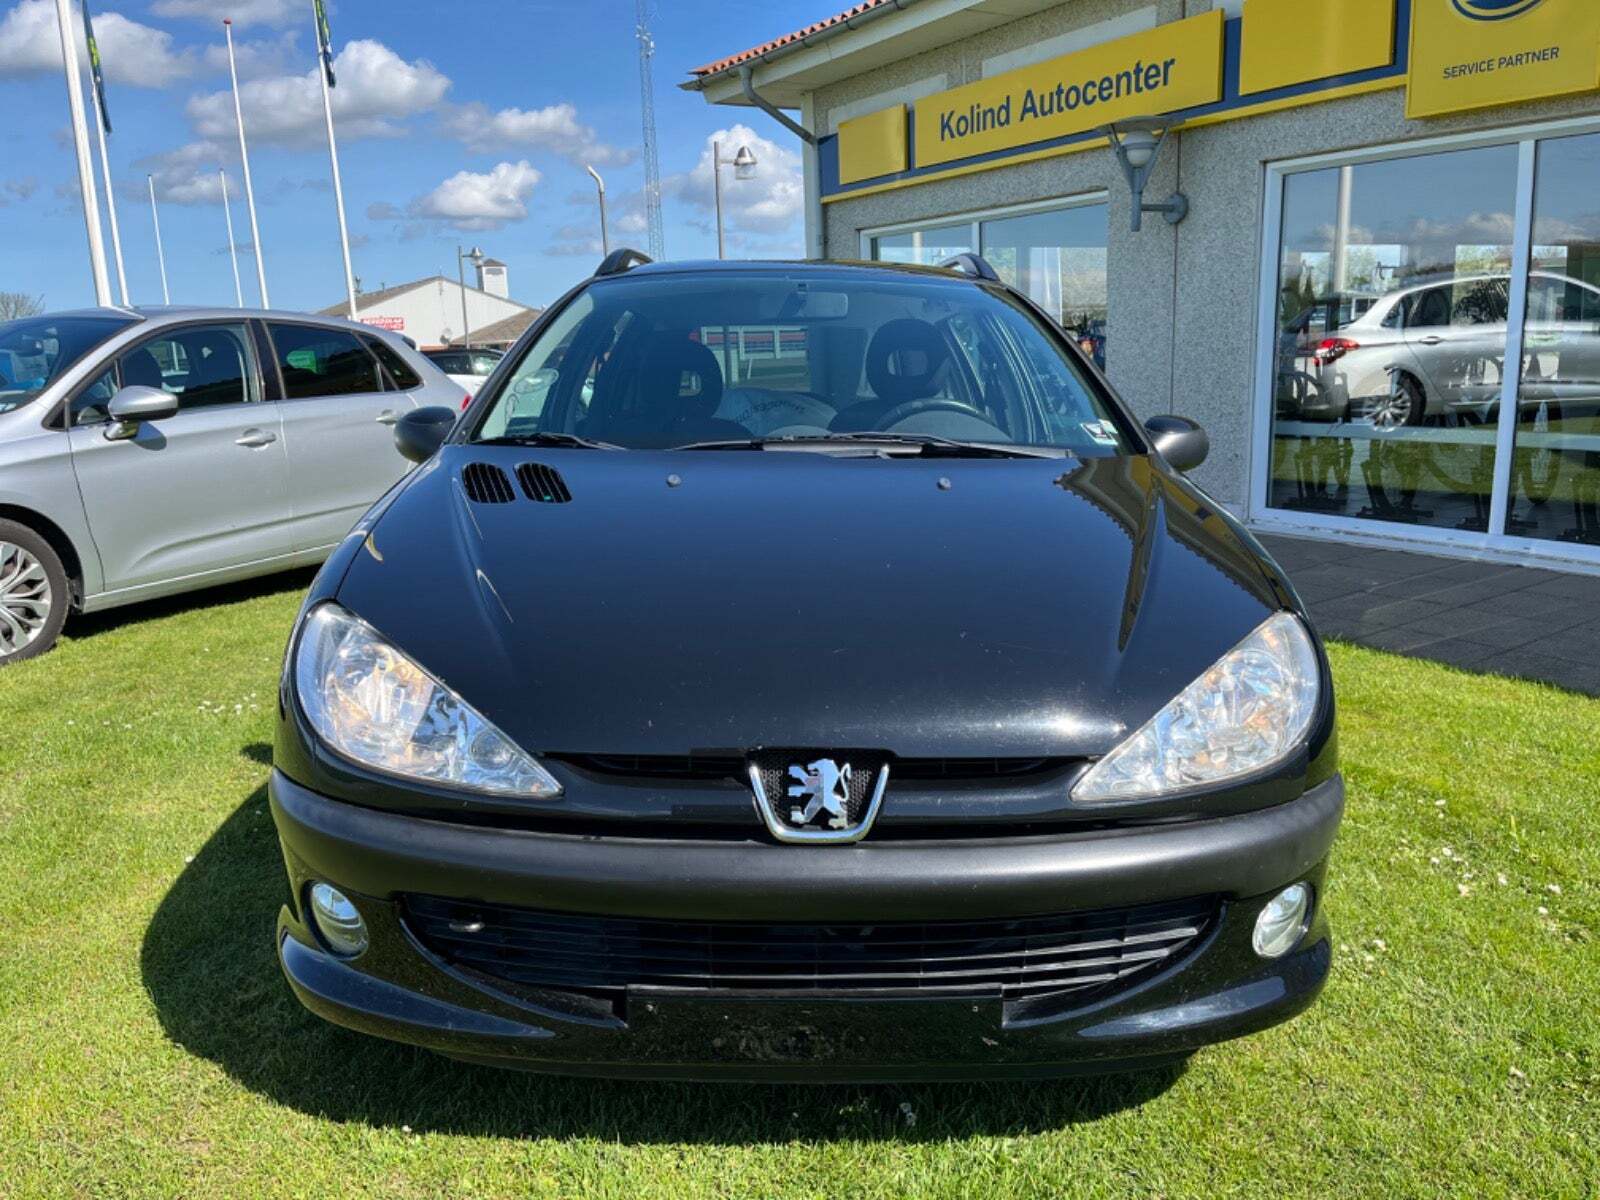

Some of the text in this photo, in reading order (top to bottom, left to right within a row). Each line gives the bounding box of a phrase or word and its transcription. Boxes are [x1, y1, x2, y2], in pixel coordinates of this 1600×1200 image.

[1443, 47, 1560, 79] SERVICE PARTNER
[940, 58, 1176, 142] Kolind Autocenter
